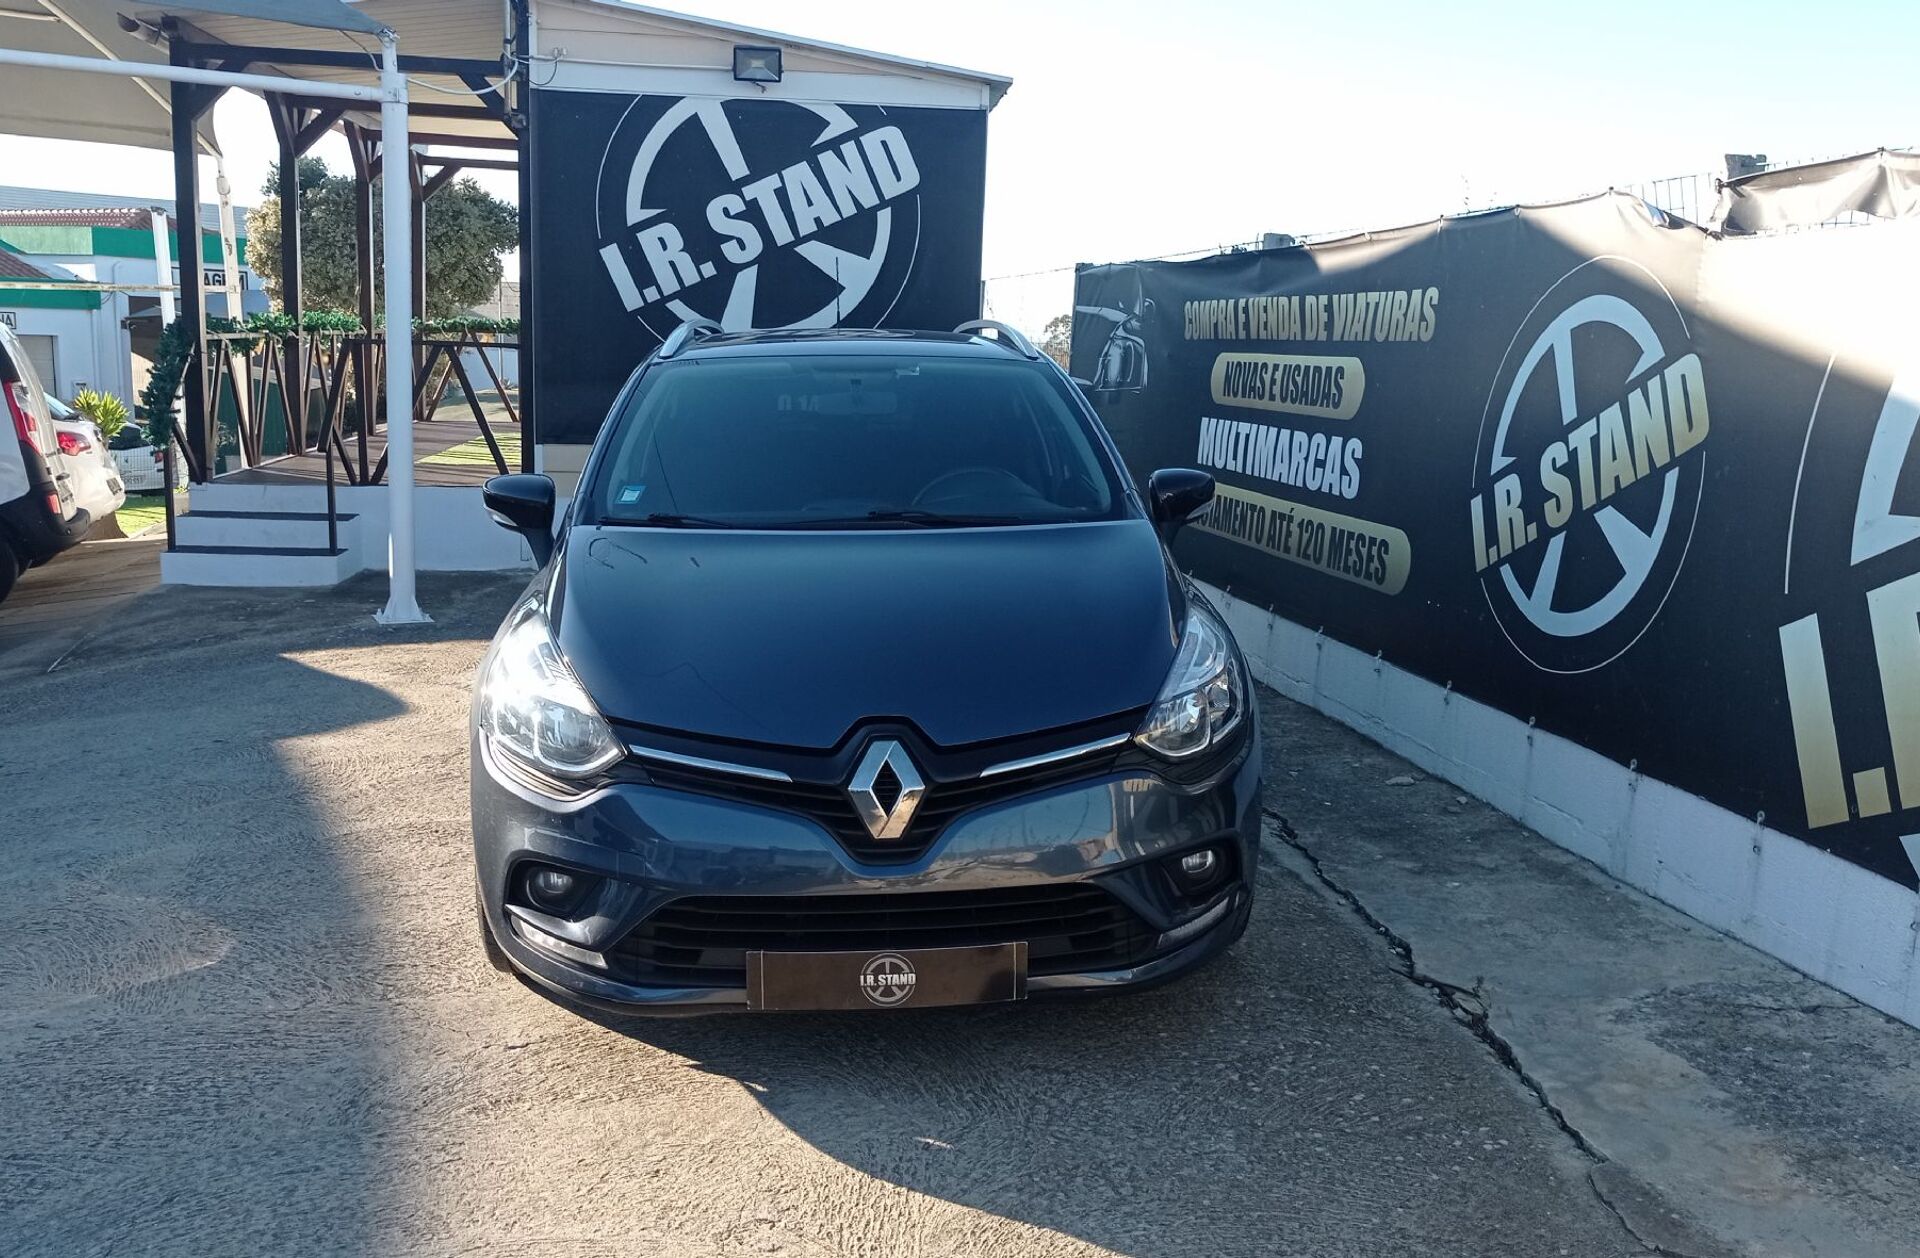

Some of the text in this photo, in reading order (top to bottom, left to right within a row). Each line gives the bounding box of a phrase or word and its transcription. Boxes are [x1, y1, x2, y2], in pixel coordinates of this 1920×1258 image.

[599, 125, 921, 313] I.R. STAND
[1183, 286, 1440, 343] COMPRA E VENDA DE VIATURAS
[1223, 361, 1345, 410] NOVAS E USADAS
[1197, 416, 1363, 500] MULTIMARCAS
[1470, 353, 1710, 573] I.R. STAND
[1266, 507, 1295, 554] ATÉ
[1296, 517, 1325, 565] 120
[1326, 526, 1390, 585] MESES
[860, 973, 916, 986] I.R. STAND
